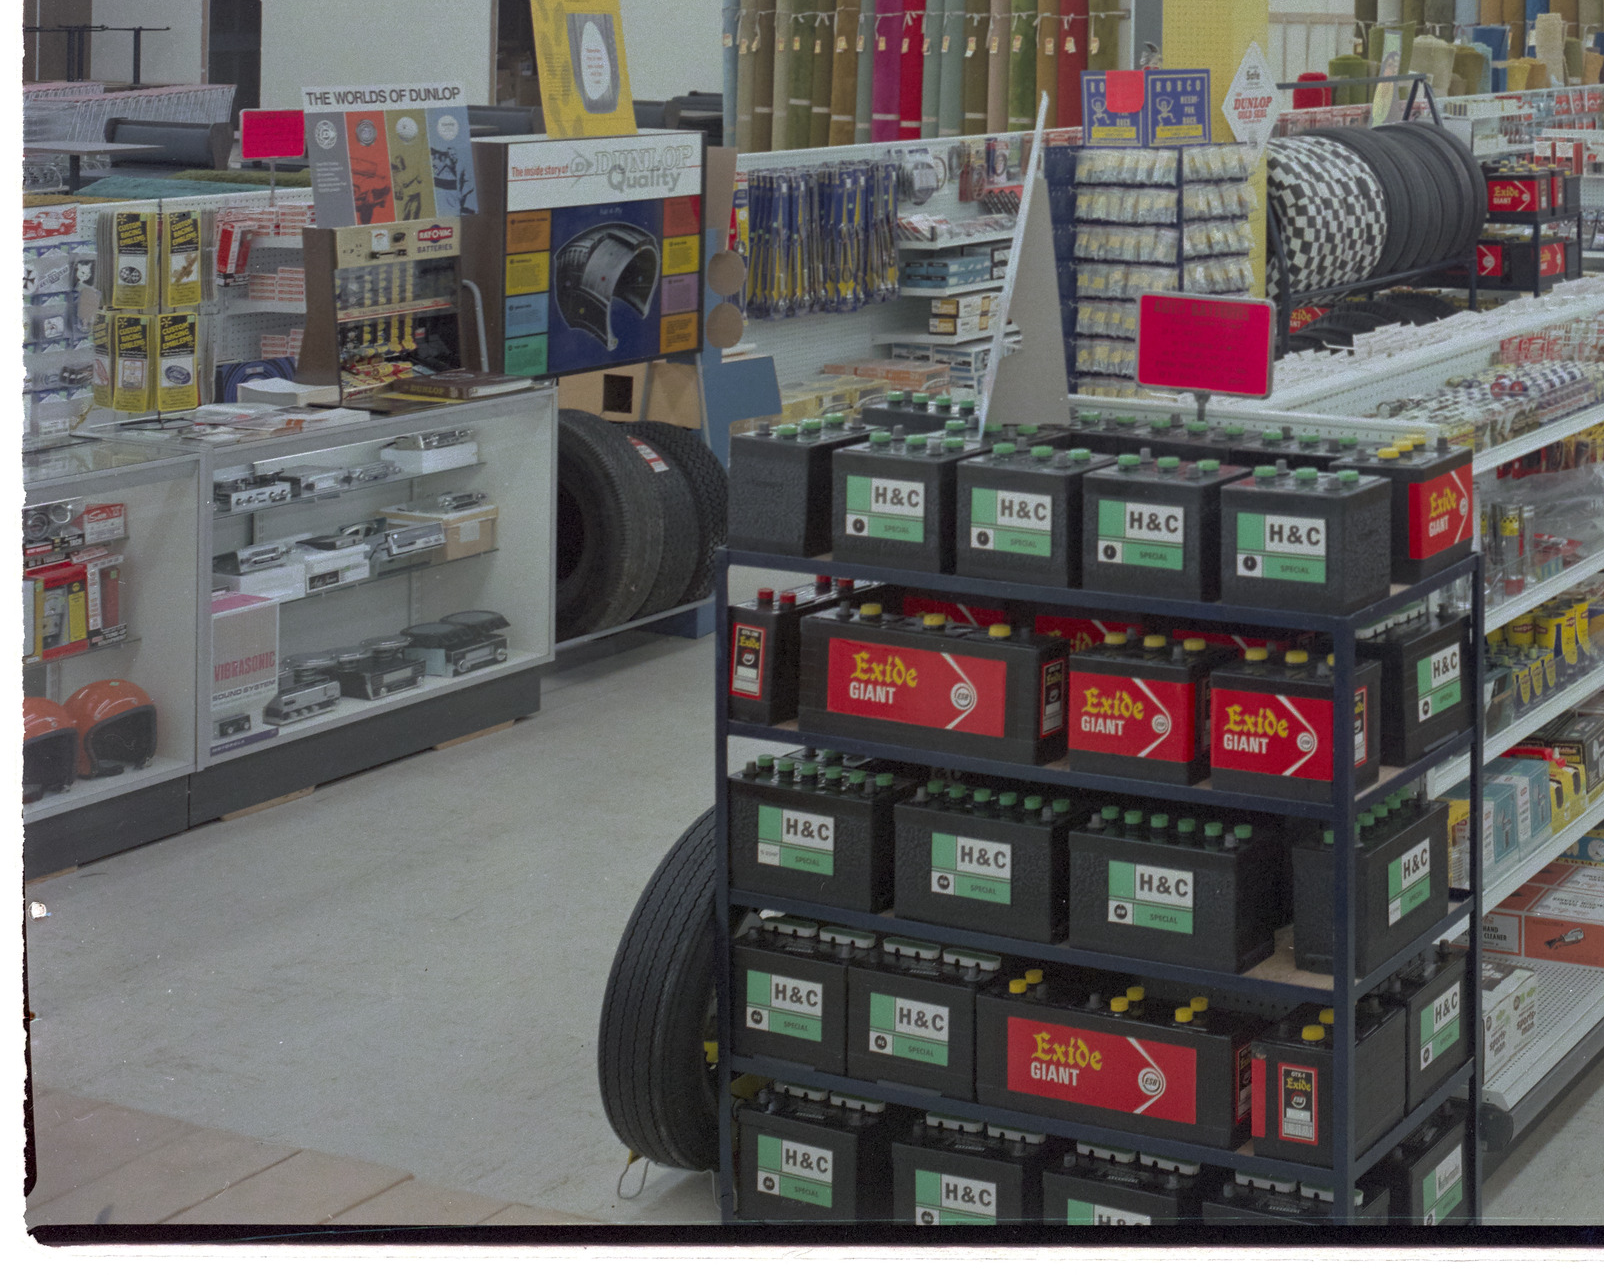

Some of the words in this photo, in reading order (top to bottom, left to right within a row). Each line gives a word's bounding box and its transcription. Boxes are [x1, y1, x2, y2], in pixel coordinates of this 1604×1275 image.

[305, 91, 332, 106] THE
[333, 89, 387, 105] WORLDS
[389, 88, 407, 103] OF
[409, 86, 461, 102] DUNLOP
[1234, 96, 1272, 110] DUNLOP
[512, 166, 523, 178] The
[524, 165, 544, 177] inside
[544, 165, 561, 176] story
[595, 145, 693, 175] DUNLOP
[607, 164, 681, 193] Quality
[1493, 186, 1519, 198] Exide
[1493, 197, 1511, 205] GIANT
[418, 228, 453, 240] RAY-O-VAC
[417, 243, 453, 254] BATTERIES
[410, 385, 444, 395] DUNLOP
[874, 486, 919, 508] H&C
[1429, 486, 1457, 519] Exide
[1000, 498, 1047, 521] H&C
[1129, 511, 1179, 534] H&C
[1428, 514, 1449, 537] GIANT
[1269, 523, 1321, 546] H&C
[737, 635, 760, 650] Exide
[214, 650, 276, 682] VIBRASONIC
[851, 651, 918, 688] Exide
[1433, 650, 1458, 680] H&C
[212, 687, 242, 701] SOUND
[243, 678, 276, 693] SYSTEM
[849, 681, 896, 704] GIANT
[1082, 687, 1144, 721] Exide
[1080, 715, 1125, 737] GIANT
[1223, 704, 1290, 739] Exide
[1223, 733, 1269, 755] GIANT
[785, 817, 830, 842] H&C
[960, 844, 1007, 869] H&C
[1403, 847, 1428, 880] H&C
[1138, 873, 1189, 898] H&C
[1149, 913, 1179, 925] SPECIAL
[1484, 933, 1507, 942] CLEANER
[774, 982, 818, 1007] H&C
[899, 1006, 945, 1032] H&C
[1435, 991, 1458, 1025] H&C
[1031, 1031, 1103, 1071] Exide
[1030, 1061, 1080, 1087] GIANT
[1285, 1077, 1312, 1093] Exide
[785, 1148, 829, 1174] H&C
[945, 1181, 992, 1207] H&C
